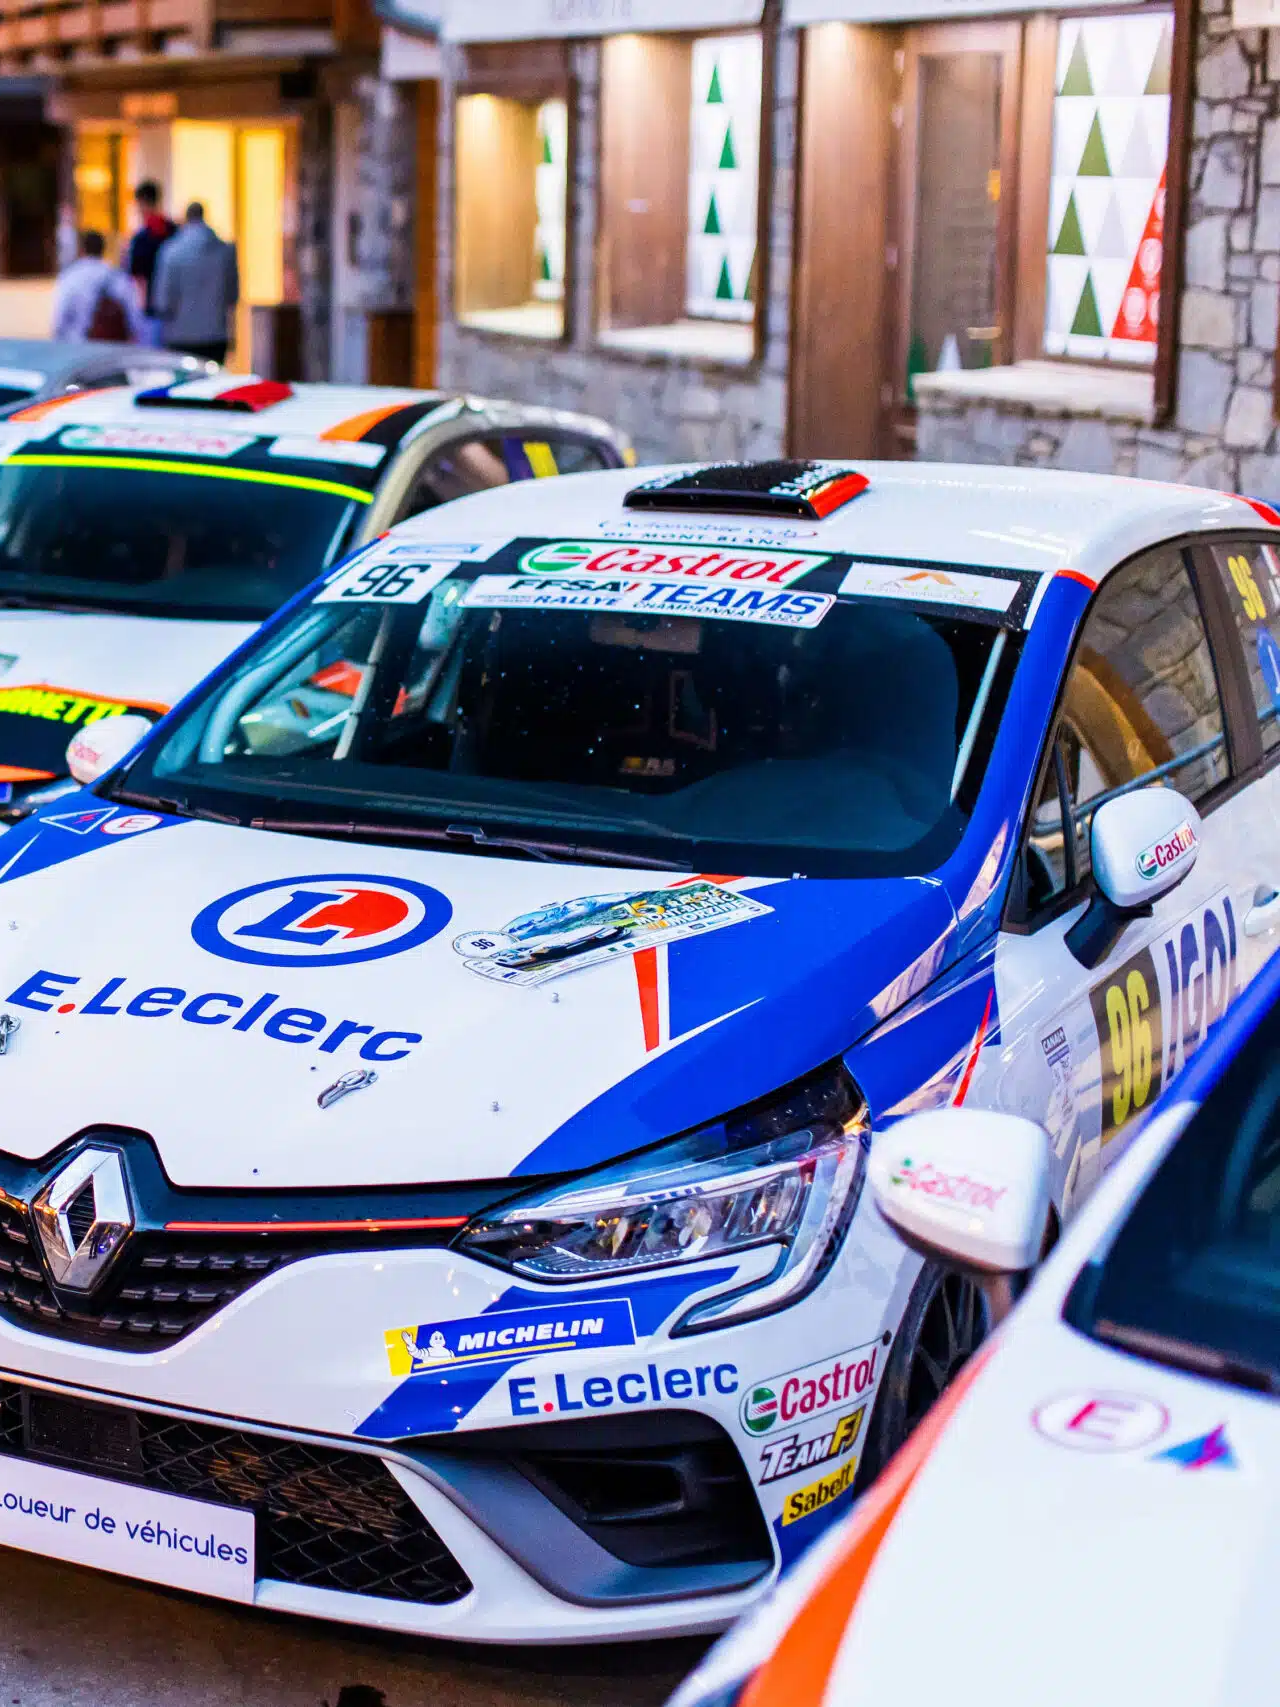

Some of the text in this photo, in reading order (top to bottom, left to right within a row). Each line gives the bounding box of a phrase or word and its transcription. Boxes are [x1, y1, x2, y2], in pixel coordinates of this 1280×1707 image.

[341, 564, 431, 597] 96
[585, 548, 805, 584] Castrol
[534, 595, 622, 606] RALLYE
[633, 602, 755, 618] CHAMPIONNAT
[642, 583, 825, 615] TEAMS
[1155, 823, 1197, 867] Castrol
[470, 938, 496, 950] 96
[5, 969, 424, 1062] E.Leclerc
[1105, 969, 1152, 1126] 96
[457, 1318, 604, 1352] MICHELIN
[508, 1363, 738, 1416] E.Leclerc
[781, 1347, 877, 1421] Castrol
[789, 1464, 852, 1518] Sabelt
[84, 1507, 117, 1535] de
[126, 1519, 249, 1566] véhicules
